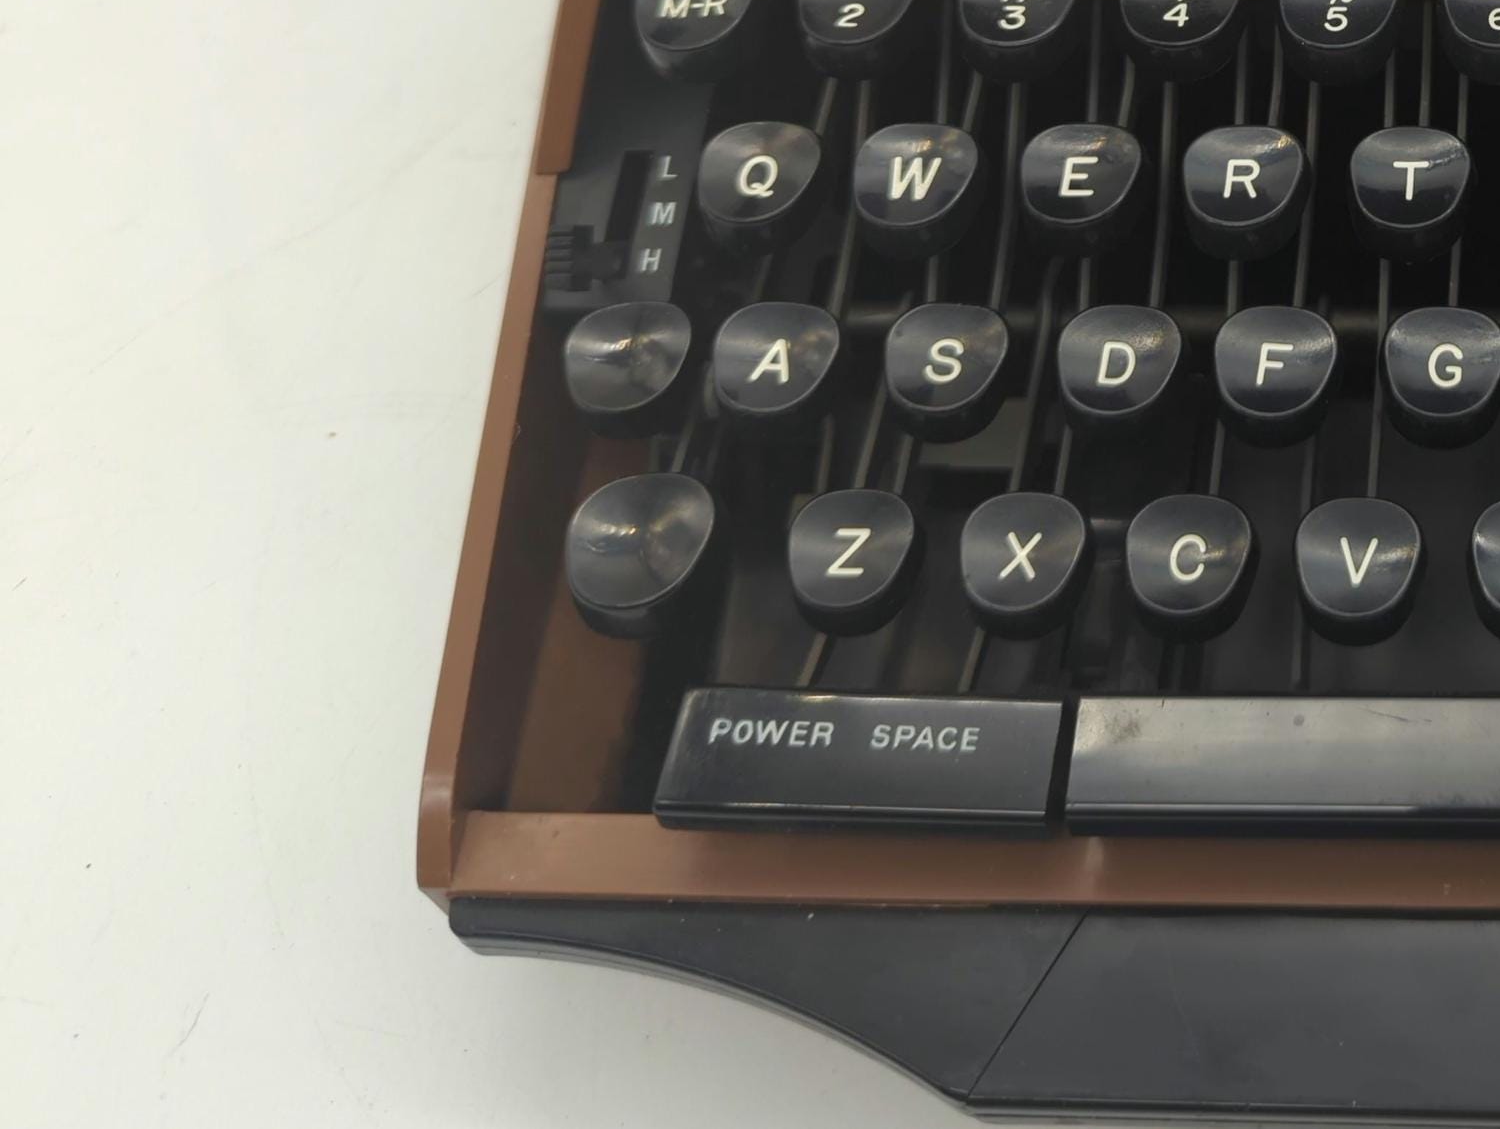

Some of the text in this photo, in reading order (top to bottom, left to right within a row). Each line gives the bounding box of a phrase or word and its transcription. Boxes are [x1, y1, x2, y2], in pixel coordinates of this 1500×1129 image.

[836, 3, 865, 28] 2
[999, 5, 1026, 30] 3
[1162, 2, 1189, 27] 4
[1324, 6, 1348, 32] 5
[660, 155, 677, 179] L
[737, 155, 778, 199] Q
[889, 157, 942, 201] W
[1060, 156, 1099, 197] E
[1223, 159, 1261, 199] R
[1392, 160, 1431, 201] T
[650, 201, 676, 225] M
[640, 248, 662, 272] H
[749, 338, 789, 383] A
[924, 338, 964, 383] S
[1097, 341, 1136, 386] D
[1256, 342, 1294, 386] F
[1428, 343, 1464, 388] G
[827, 528, 871, 576] Z
[999, 531, 1042, 579] X
[1169, 534, 1206, 582] C
[1340, 537, 1378, 585] V
[709, 718, 980, 751] POWER SPACE
